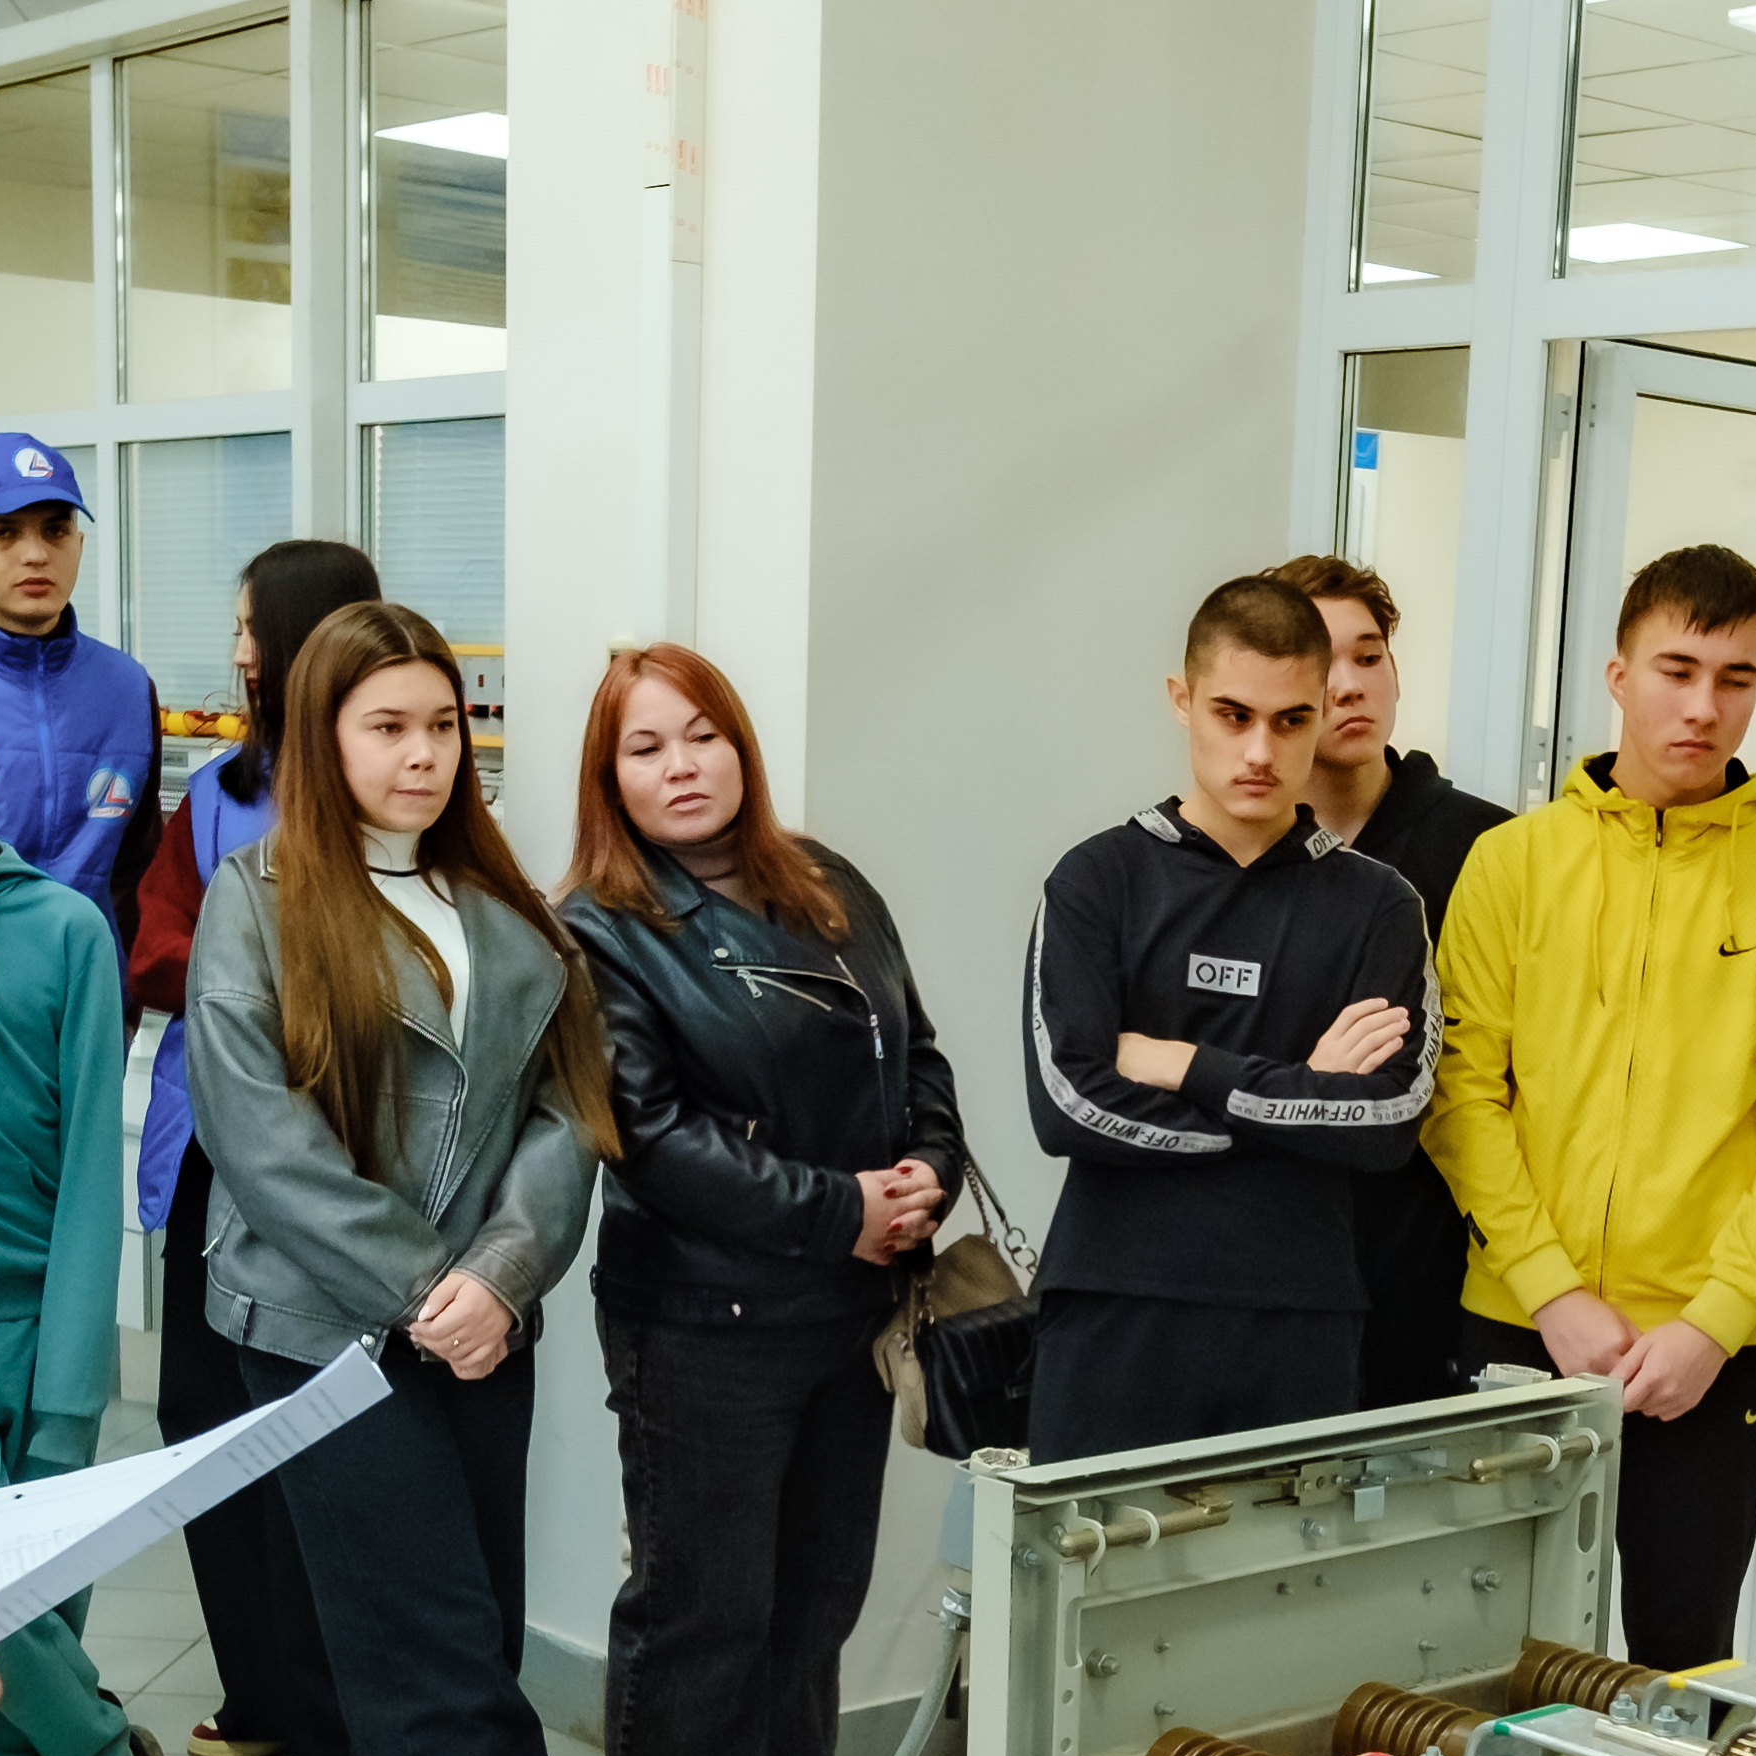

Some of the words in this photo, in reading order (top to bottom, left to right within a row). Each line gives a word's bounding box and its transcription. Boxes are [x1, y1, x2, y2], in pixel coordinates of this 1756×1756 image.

[1195, 962, 1253, 989] OFF
[1263, 1102, 1366, 1122] OFF-WHITE
[1079, 1107, 1181, 1149] OFF-WHITE
